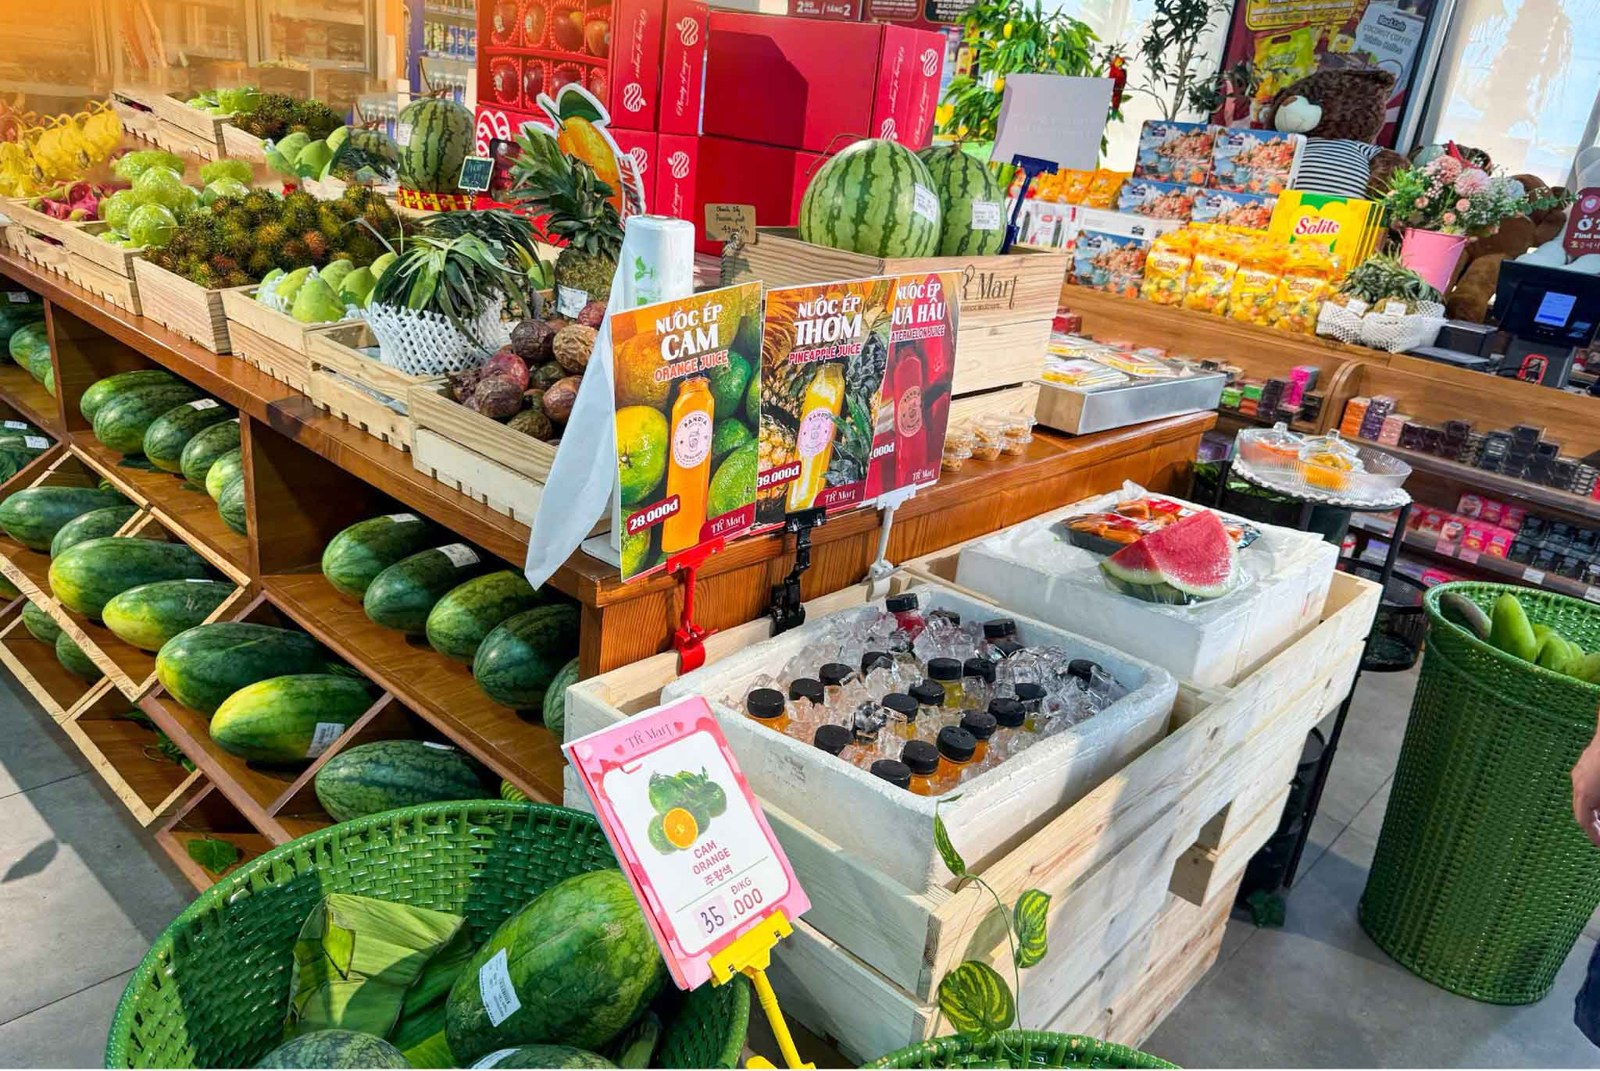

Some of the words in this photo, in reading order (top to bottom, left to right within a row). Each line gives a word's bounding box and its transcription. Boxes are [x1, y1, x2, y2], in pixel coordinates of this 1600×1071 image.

[1295, 217, 1339, 235] Solite
[976, 273, 1019, 310] Mart
[892, 304, 914, 325] ƯA
[794, 313, 862, 346] THƠM
[889, 327, 926, 343] ATERMELON
[661, 323, 719, 361] CAM
[788, 345, 837, 365] PINEAPPLE
[837, 342, 861, 357] JUICE
[654, 358, 699, 383] ORANGE
[699, 349, 729, 371] JUICE
[838, 488, 856, 501] Mart
[725, 513, 746, 530] Mart
[645, 723, 675, 740] Mart
[694, 840, 718, 859] CAM
[692, 847, 731, 875] ORANGE
[704, 864, 733, 887] 주황색
